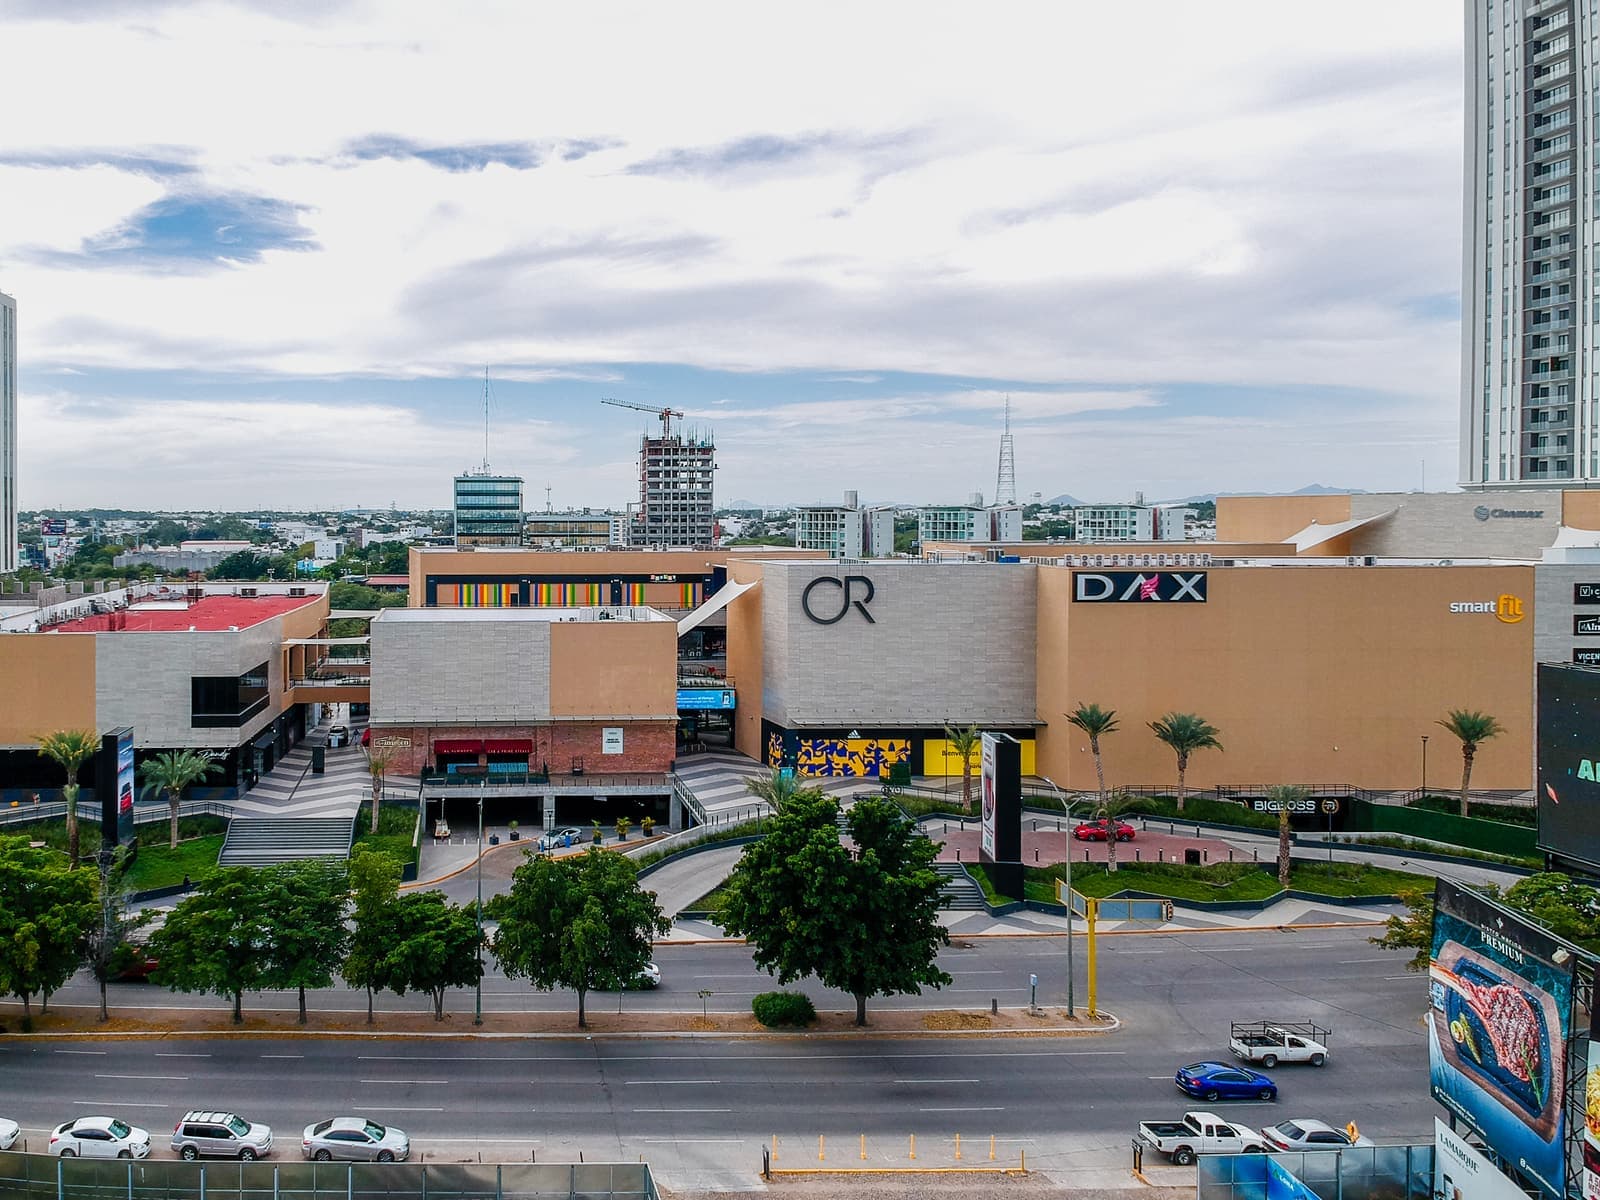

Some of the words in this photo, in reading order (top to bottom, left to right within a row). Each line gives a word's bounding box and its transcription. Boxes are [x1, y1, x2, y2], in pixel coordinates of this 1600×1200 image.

[1449, 600, 1496, 613] smart
[1498, 594, 1524, 616] fit
[1481, 931, 1523, 964] PREMIUM
[1440, 1133, 1479, 1174] LAMARQUE
